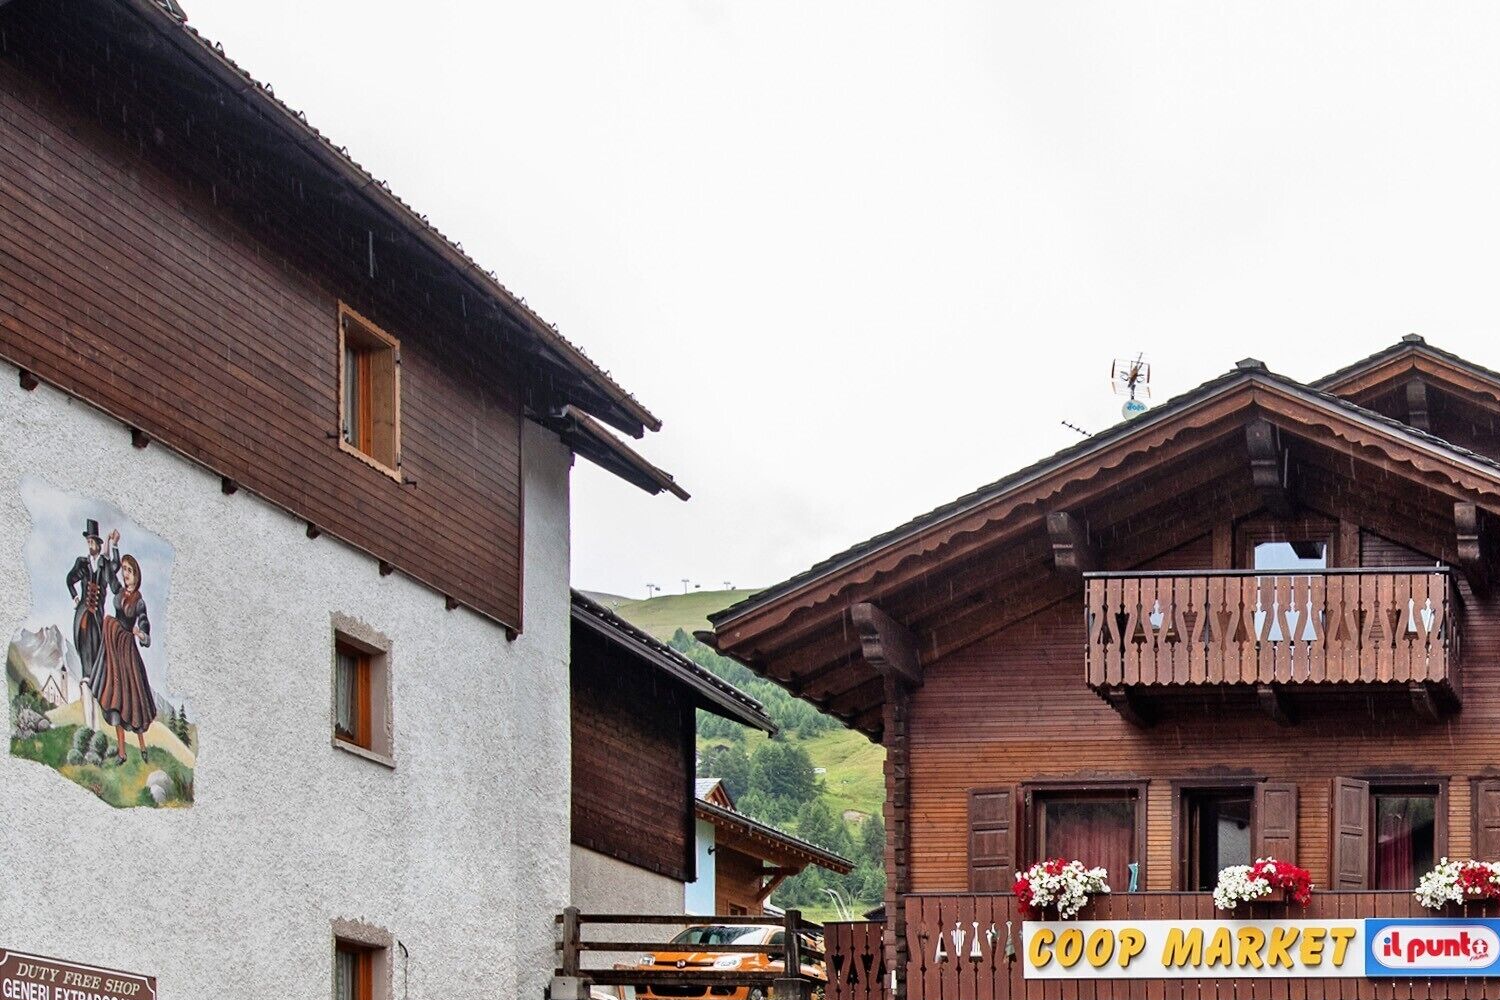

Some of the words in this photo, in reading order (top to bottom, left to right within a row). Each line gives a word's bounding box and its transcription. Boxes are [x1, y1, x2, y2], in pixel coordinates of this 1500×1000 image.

[1029, 928, 1146, 967] COOP
[1161, 927, 1356, 969] MARKET
[1384, 932, 1401, 957] il
[1407, 932, 1488, 962] punto
[16, 963, 60, 982] DUTY
[63, 970, 101, 990] FREE
[104, 978, 140, 996] SHOP
